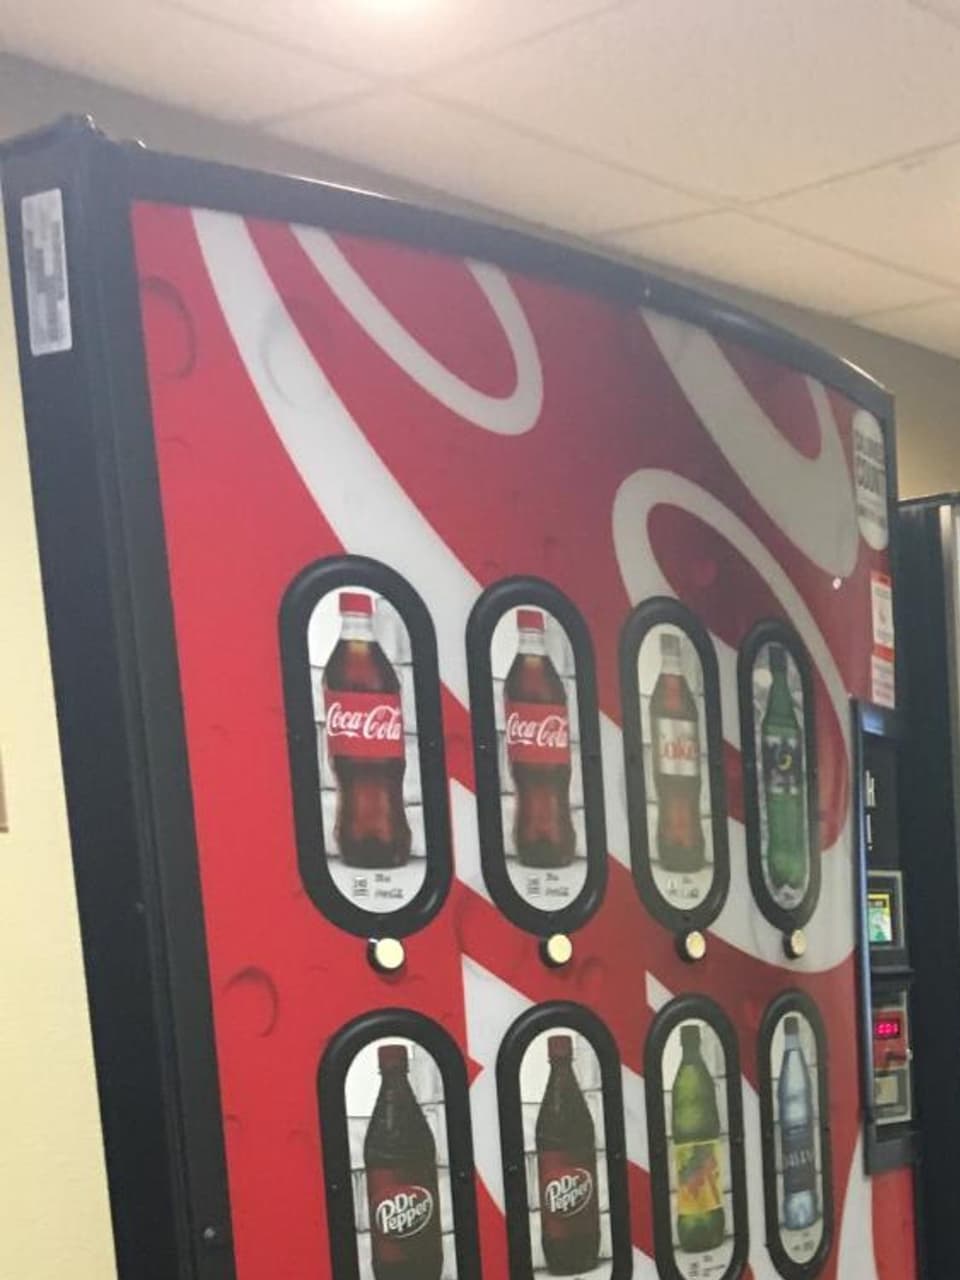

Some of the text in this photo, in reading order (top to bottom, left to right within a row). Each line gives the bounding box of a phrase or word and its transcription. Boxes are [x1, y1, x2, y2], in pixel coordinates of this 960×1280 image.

[327, 702, 401, 740] Coca-Cola
[506, 712, 568, 747] Coca-Cola
[545, 1179, 590, 1213] Pepper
[560, 1174, 580, 1193] Dr
[376, 1199, 431, 1234] Pepper
[394, 1192, 418, 1213] Dr
